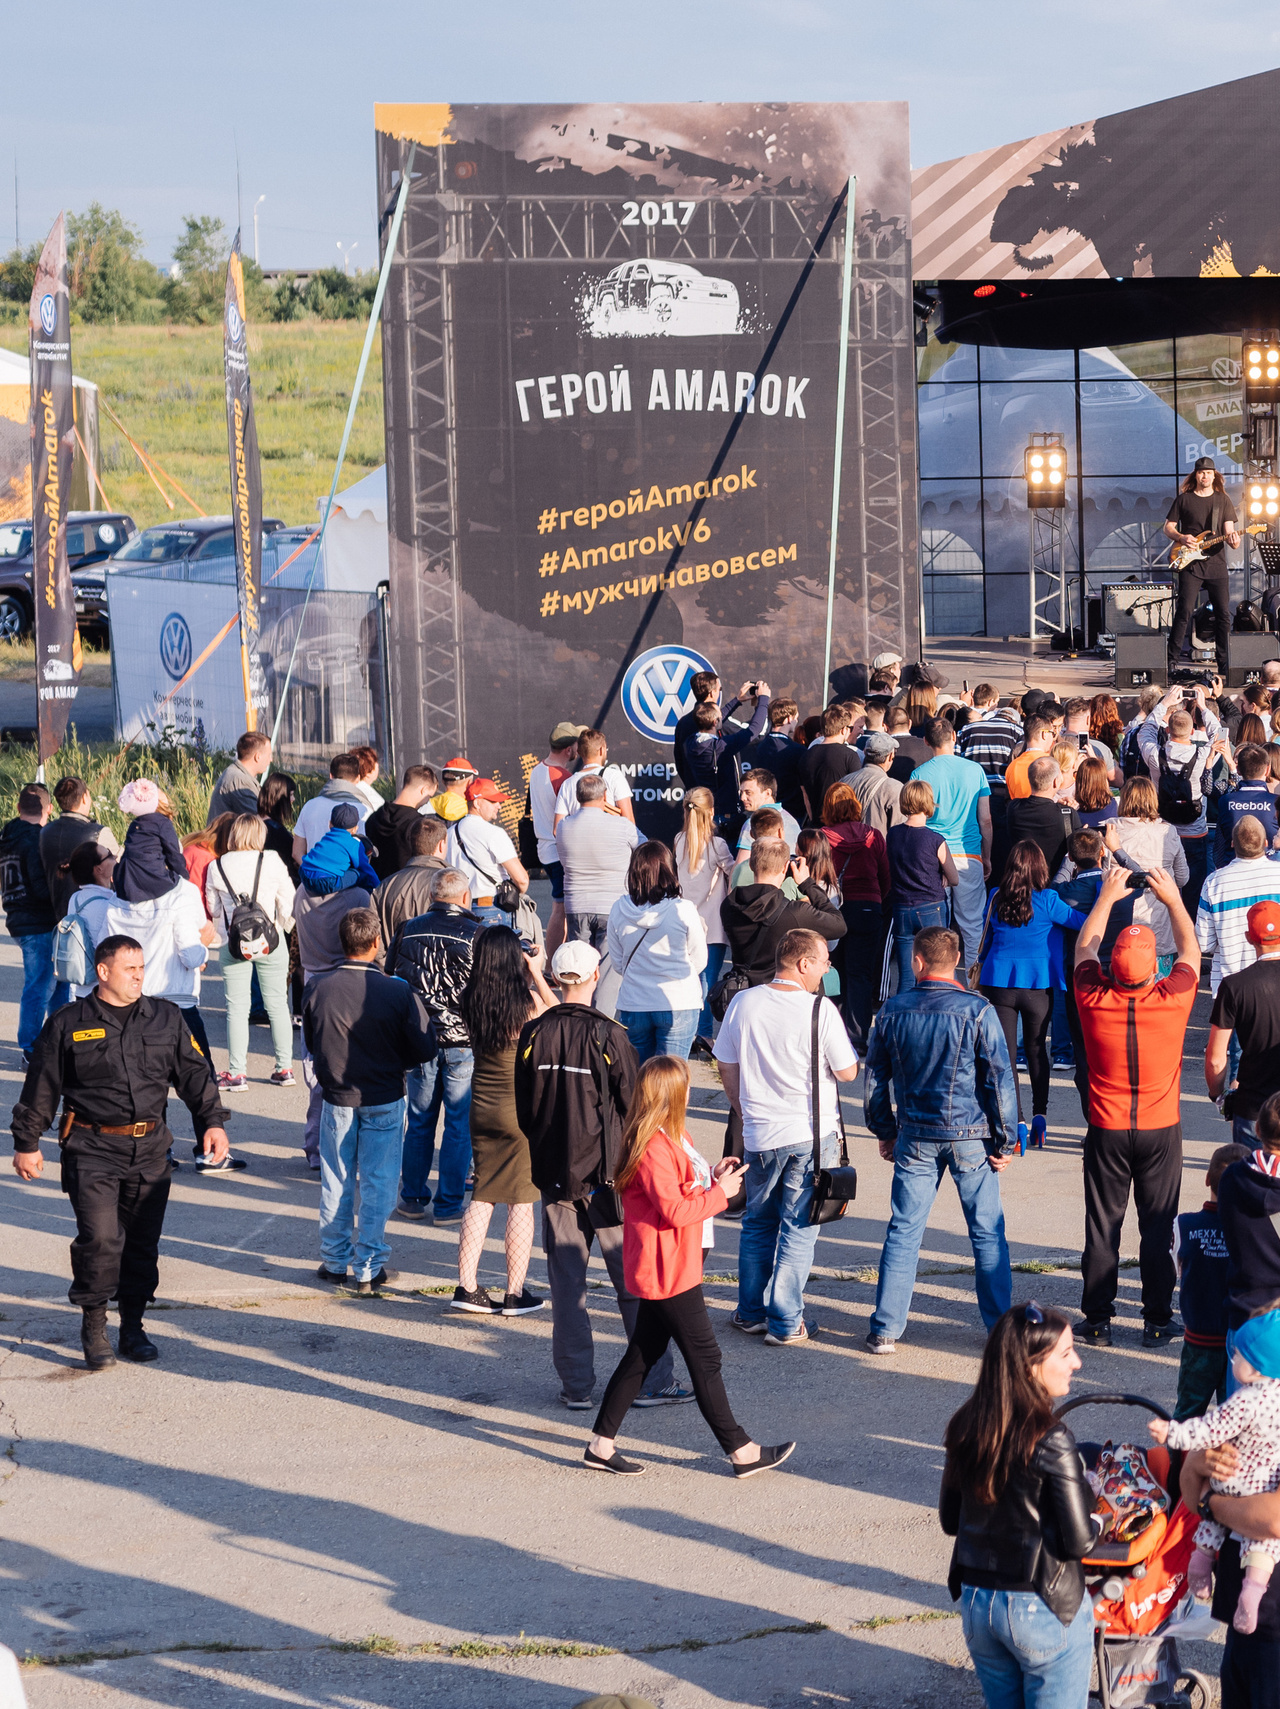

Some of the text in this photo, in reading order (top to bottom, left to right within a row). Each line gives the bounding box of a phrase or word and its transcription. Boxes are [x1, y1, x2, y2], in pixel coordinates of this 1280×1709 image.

[622, 202, 696, 226] 2017
[515, 364, 810, 422] ГЕРОЙ AMAROK
[537, 464, 758, 535] #геройAmarok
[538, 517, 712, 578] #AmarokV6
[540, 543, 798, 617] #мужчинавовсем
[153, 690, 204, 708] Комерчесие
[1228, 801, 1271, 811] Reebok
[1189, 1229, 1217, 1240] MEXX
[1130, 1587, 1174, 1620] bre
